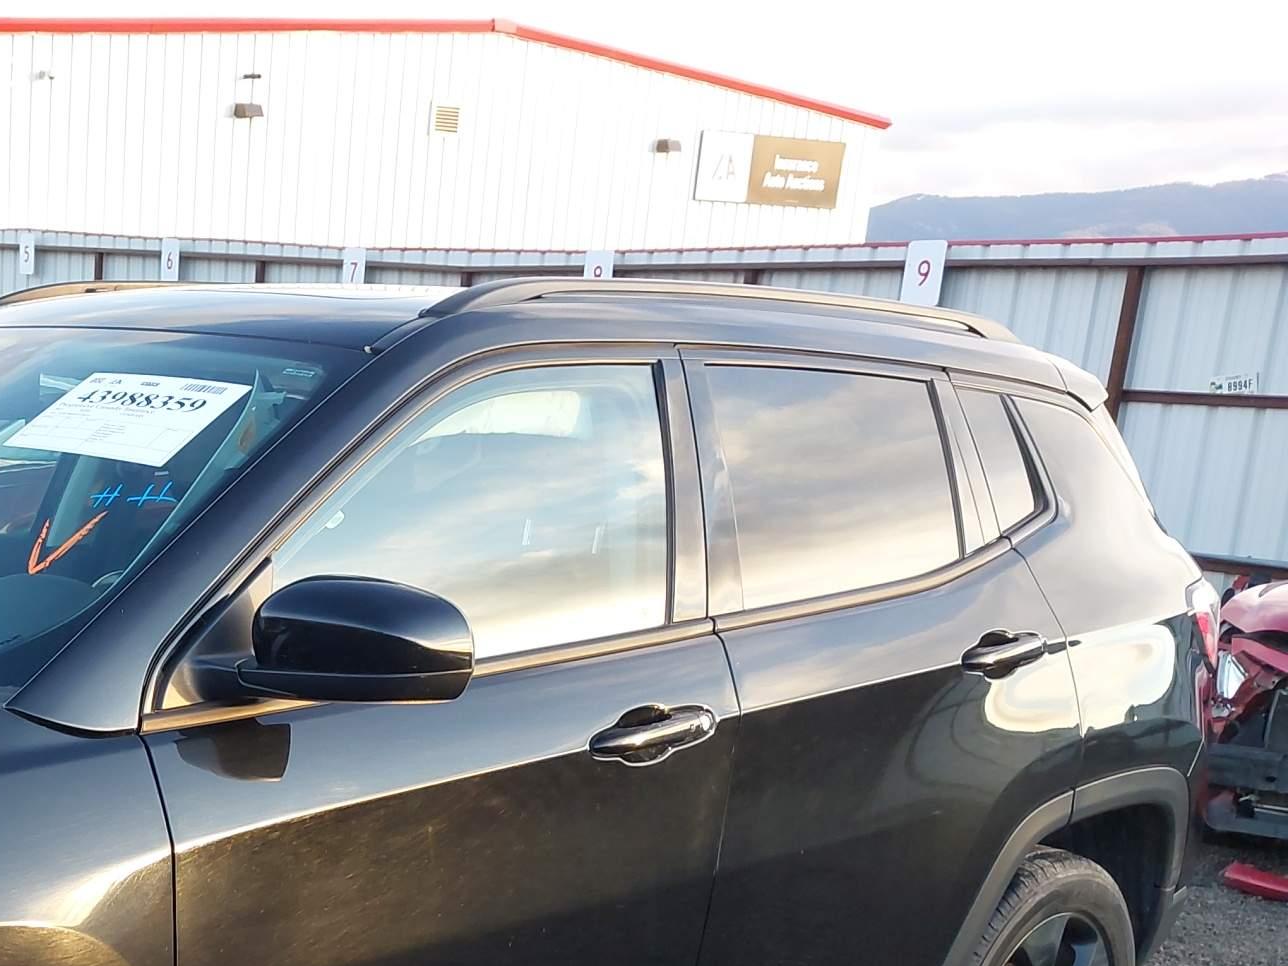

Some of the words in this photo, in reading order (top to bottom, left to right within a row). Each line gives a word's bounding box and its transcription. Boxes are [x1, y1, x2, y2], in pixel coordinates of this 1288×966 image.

[350, 261, 358, 283] 7
[917, 259, 931, 287] 9
[76, 389, 208, 413] 43988359
